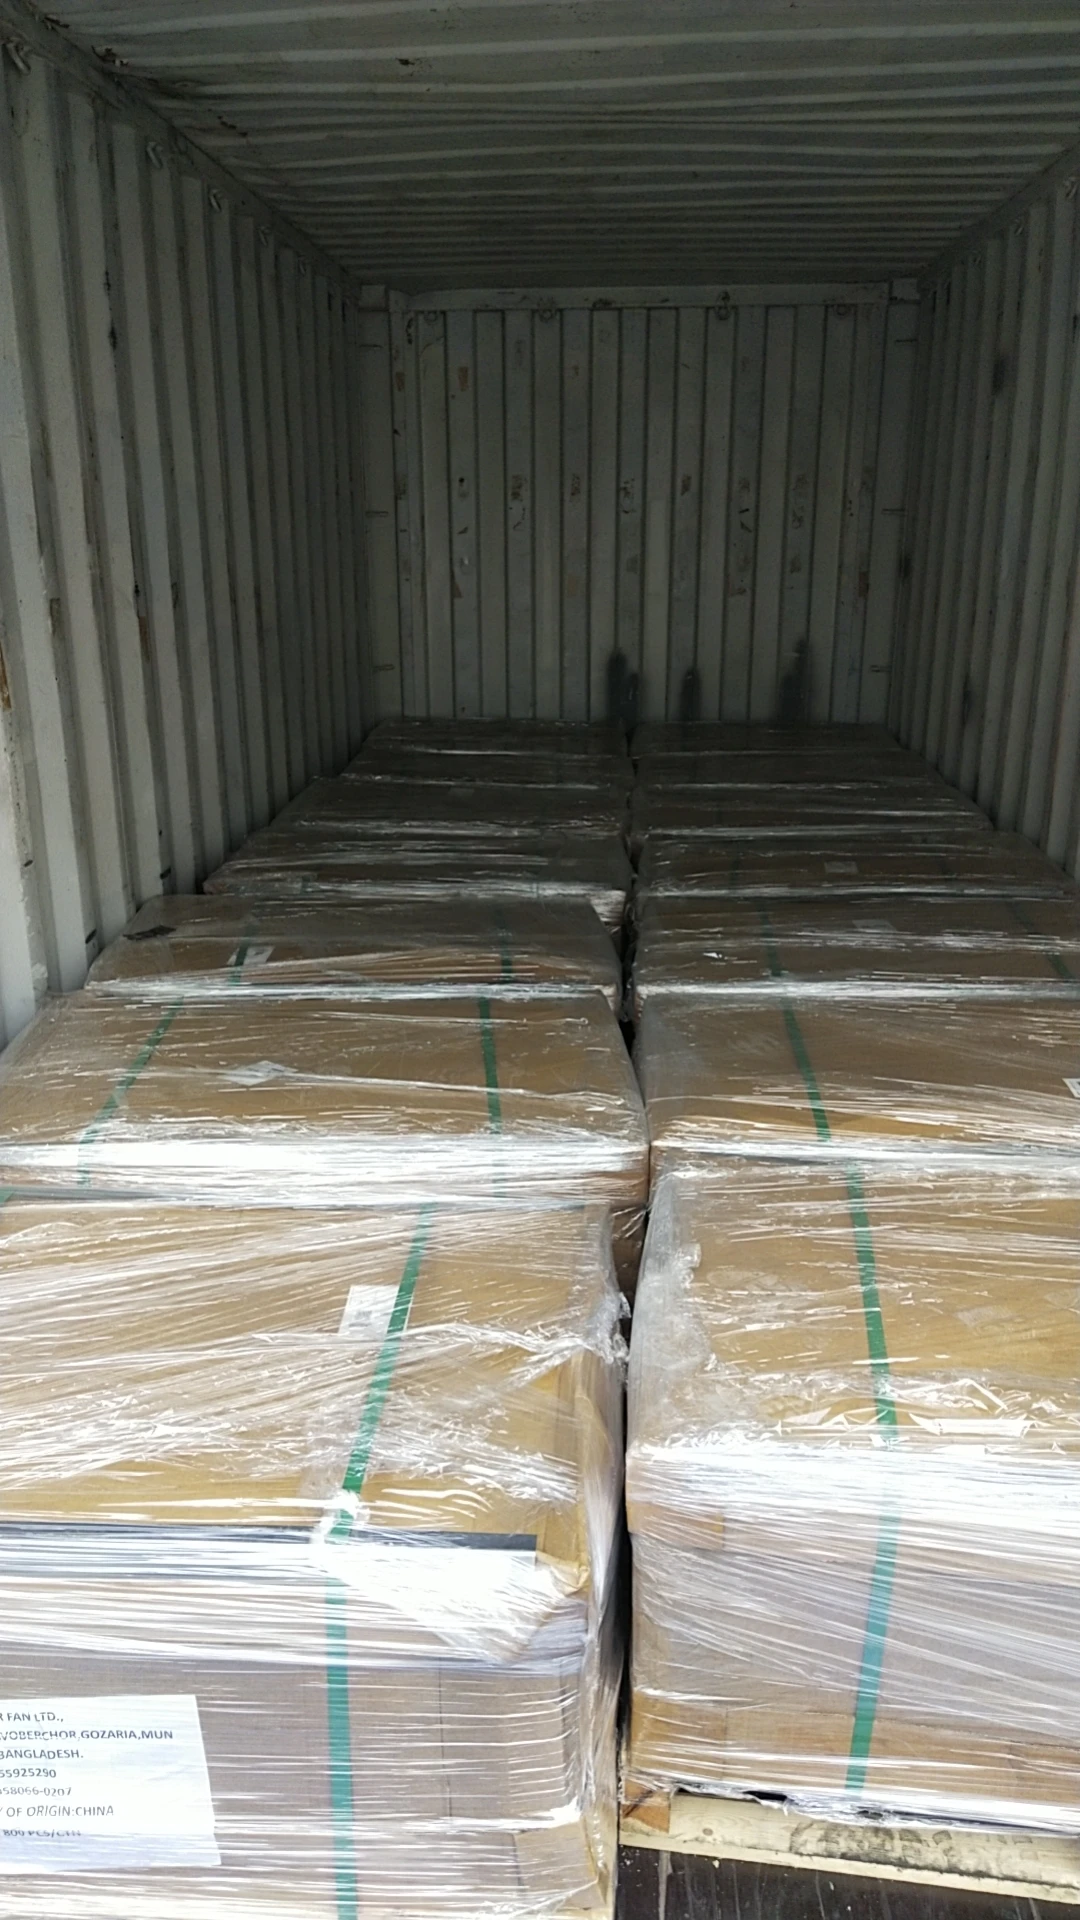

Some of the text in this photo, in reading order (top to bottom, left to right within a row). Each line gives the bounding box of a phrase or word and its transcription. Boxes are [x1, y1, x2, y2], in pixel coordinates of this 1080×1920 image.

[6, 1712, 31, 1722] FAN
[34, 1711, 64, 1722] LTD.,
[6, 1807, 22, 1817] OF
[26, 1805, 115, 1817] ORIGIN:CHINA
